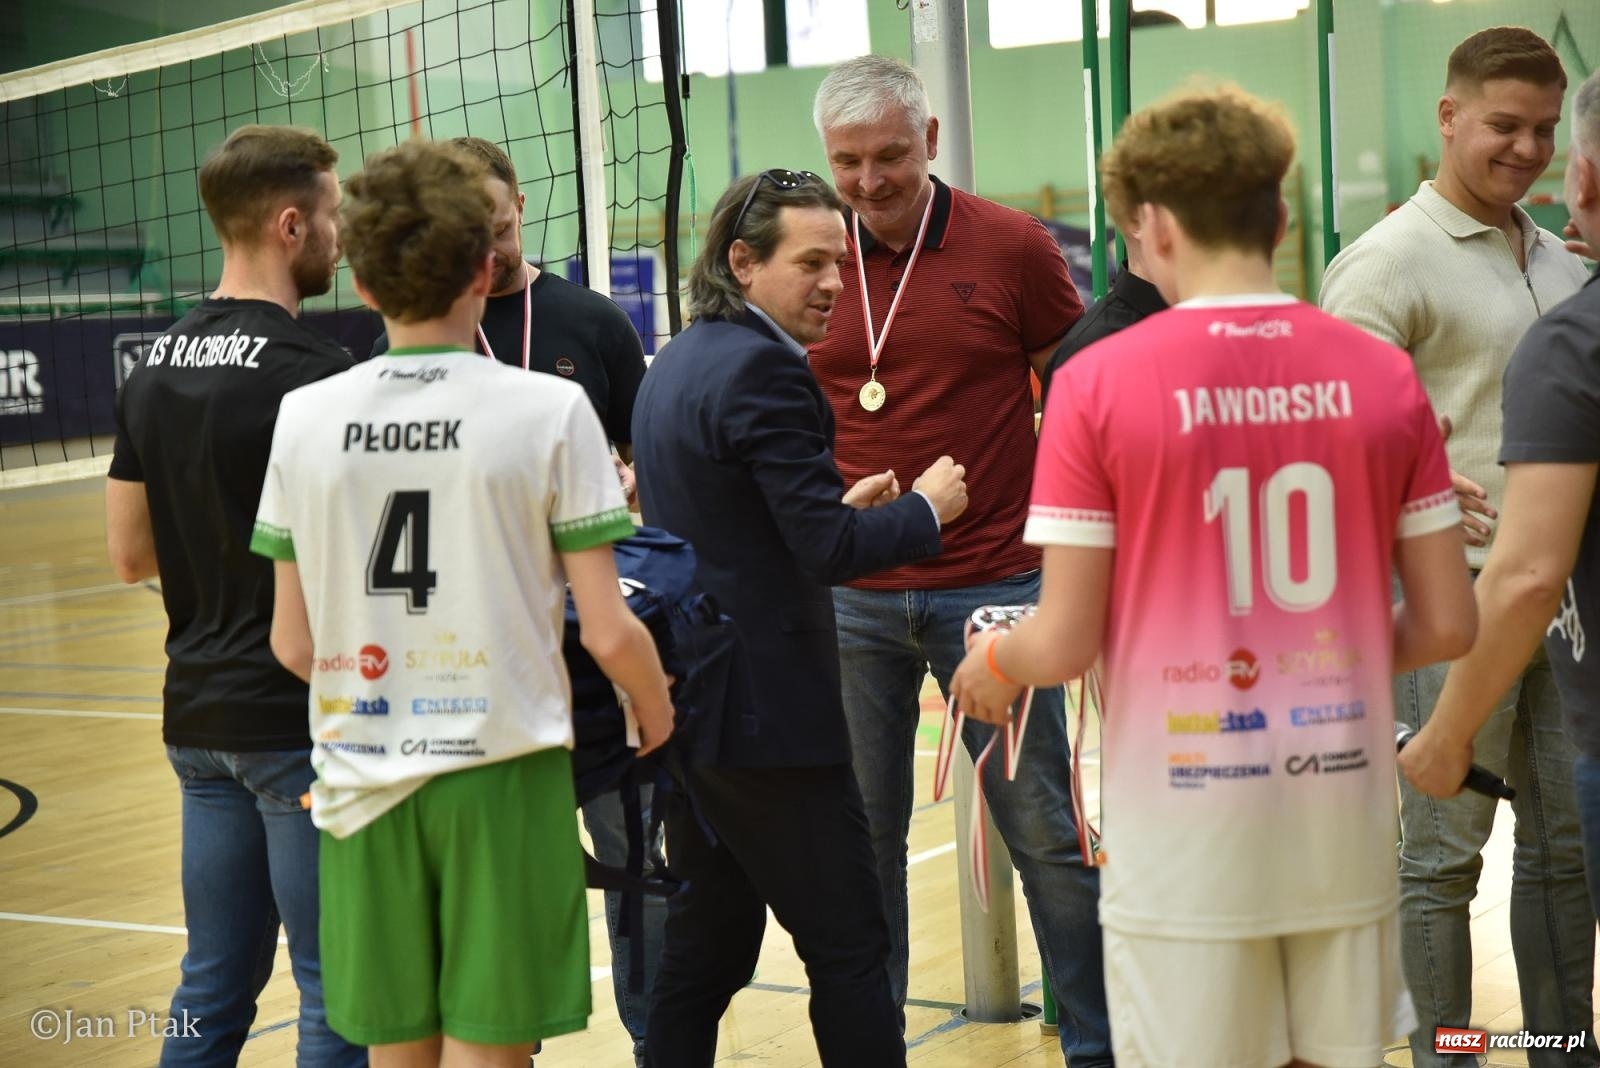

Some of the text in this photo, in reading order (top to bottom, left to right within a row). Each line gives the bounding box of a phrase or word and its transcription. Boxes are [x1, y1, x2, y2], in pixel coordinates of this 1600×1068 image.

[170, 328, 268, 368] RACIBÓRZ
[1174, 380, 1352, 435] JAWORSKI
[342, 419, 461, 452] PŁOCEK
[366, 490, 437, 615] 4
[1203, 461, 1338, 614] 10
[1163, 661, 1220, 683] radio
